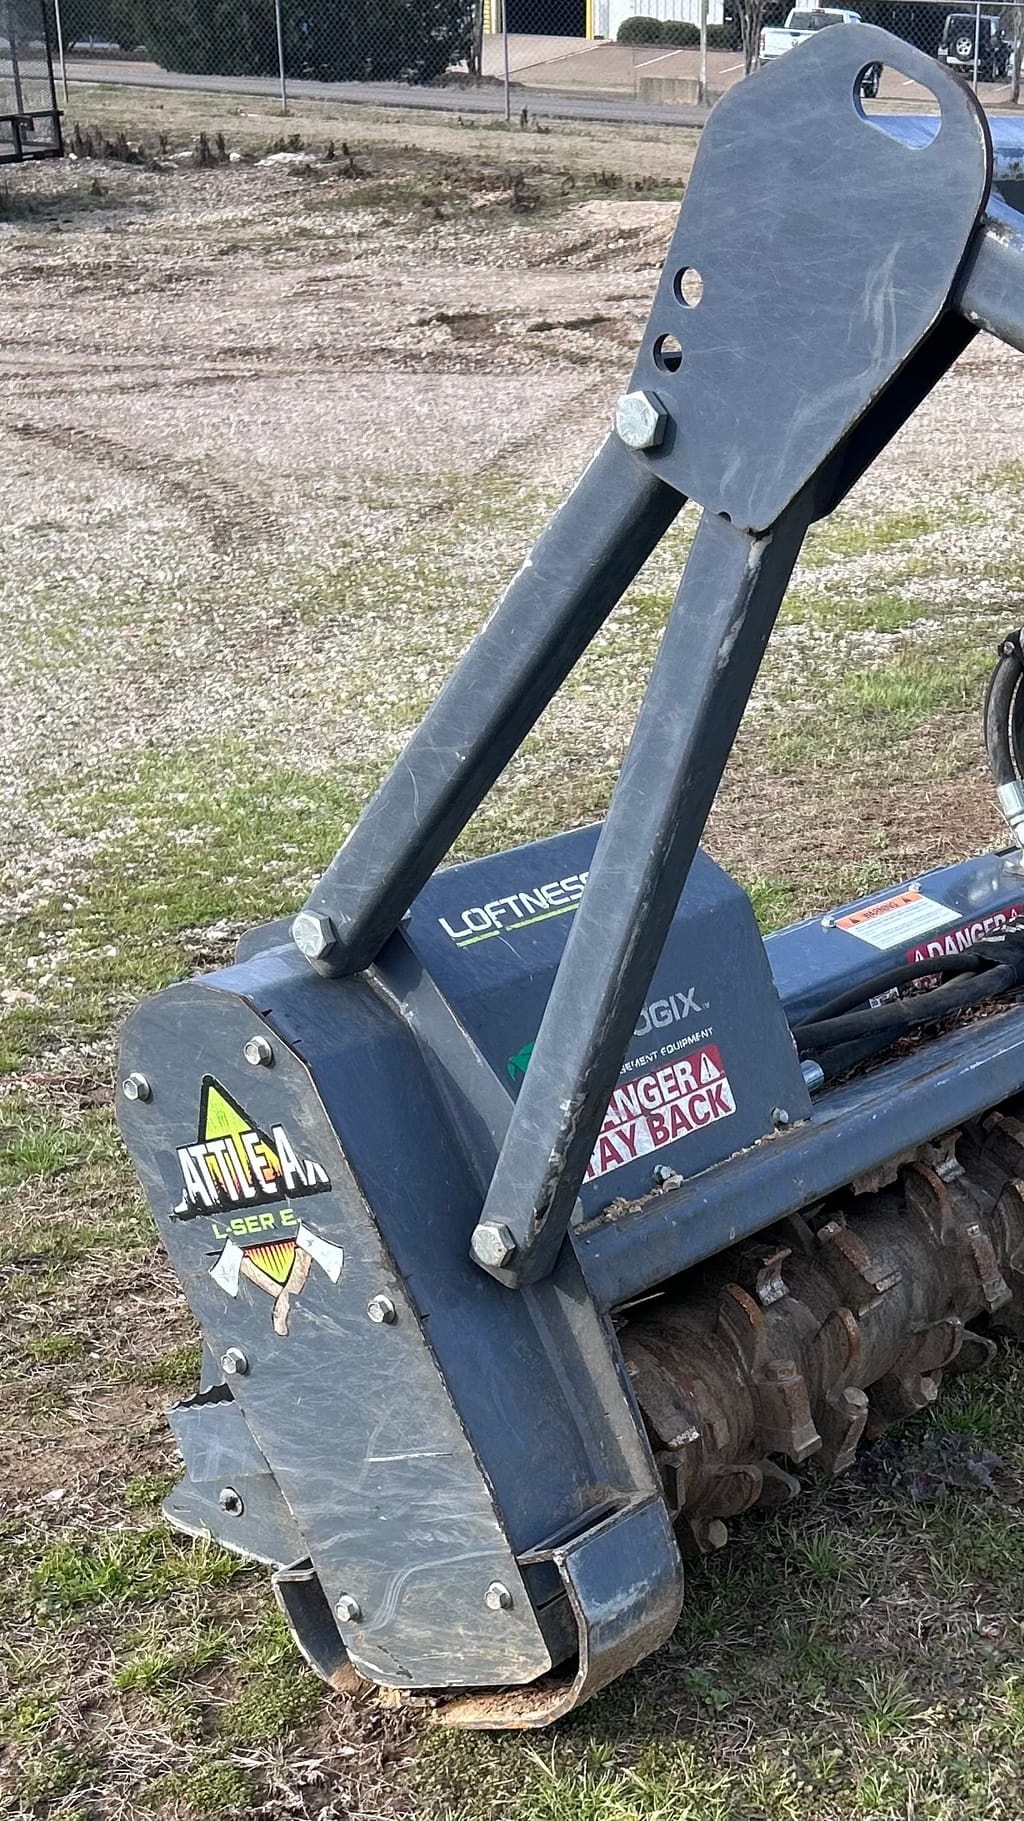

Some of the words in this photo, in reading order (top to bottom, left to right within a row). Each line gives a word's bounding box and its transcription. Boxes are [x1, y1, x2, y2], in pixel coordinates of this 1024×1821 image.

[660, 1027, 714, 1057] EQUIPMENT
[600, 1060, 699, 1133] ANGER
[646, 1082, 732, 1148] BACK
[173, 1132, 278, 1213] ATTLE
